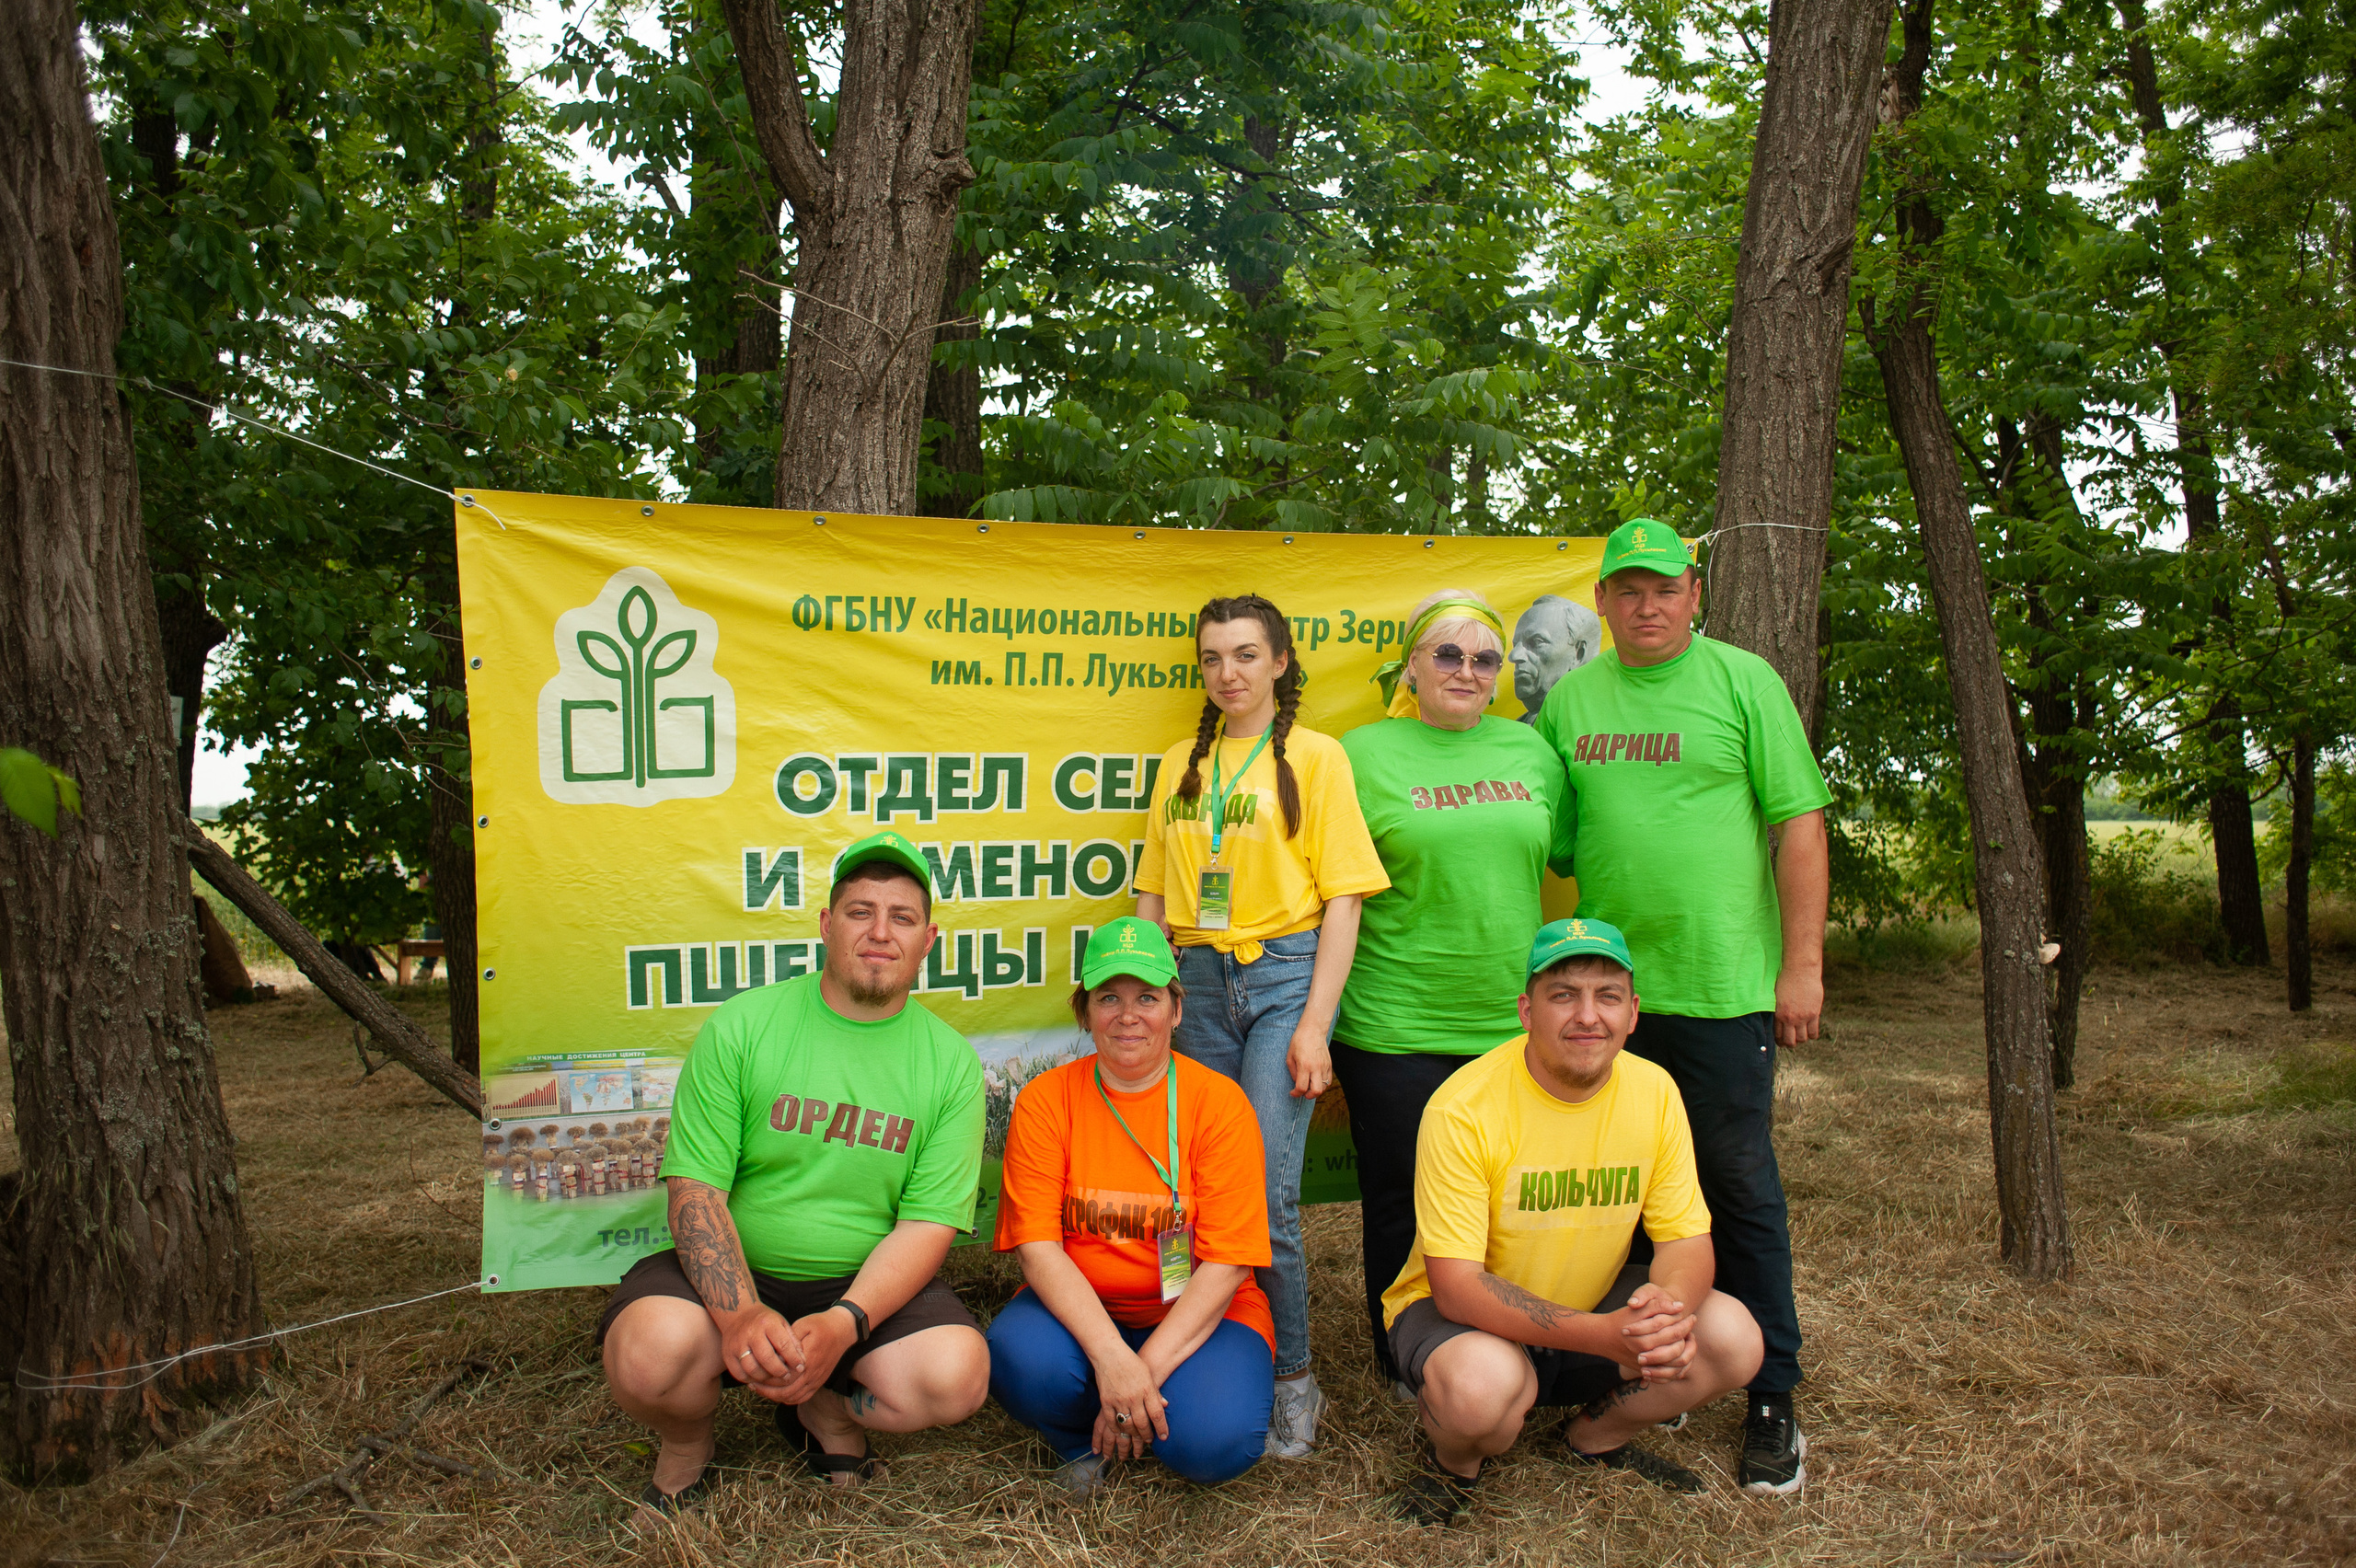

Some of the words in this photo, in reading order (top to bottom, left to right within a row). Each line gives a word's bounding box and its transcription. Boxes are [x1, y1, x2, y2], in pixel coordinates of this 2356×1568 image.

[791, 594, 917, 633] ФГБНУ
[923, 597, 1197, 640] «Национальны
[930, 660, 993, 686] им.
[1004, 651, 1075, 687] П.П.
[1574, 732, 1681, 767] ЯДРИЦА
[774, 753, 1028, 824] ОТДЕЛ
[1165, 791, 1259, 828] ТАВРДА
[1410, 779, 1533, 811] ЗДРАВА
[742, 846, 804, 911] И
[625, 927, 1046, 1010] ПШЕЦЫ
[526, 1054, 563, 1062] НАУЧНЫЕ
[566, 1052, 618, 1061] ДОСТИЖЕНИЯ
[619, 1051, 646, 1059] ЦЕНТРА
[769, 1093, 916, 1155] ОРДЕН
[1518, 1165, 1640, 1213] КОЛЬЧУГА
